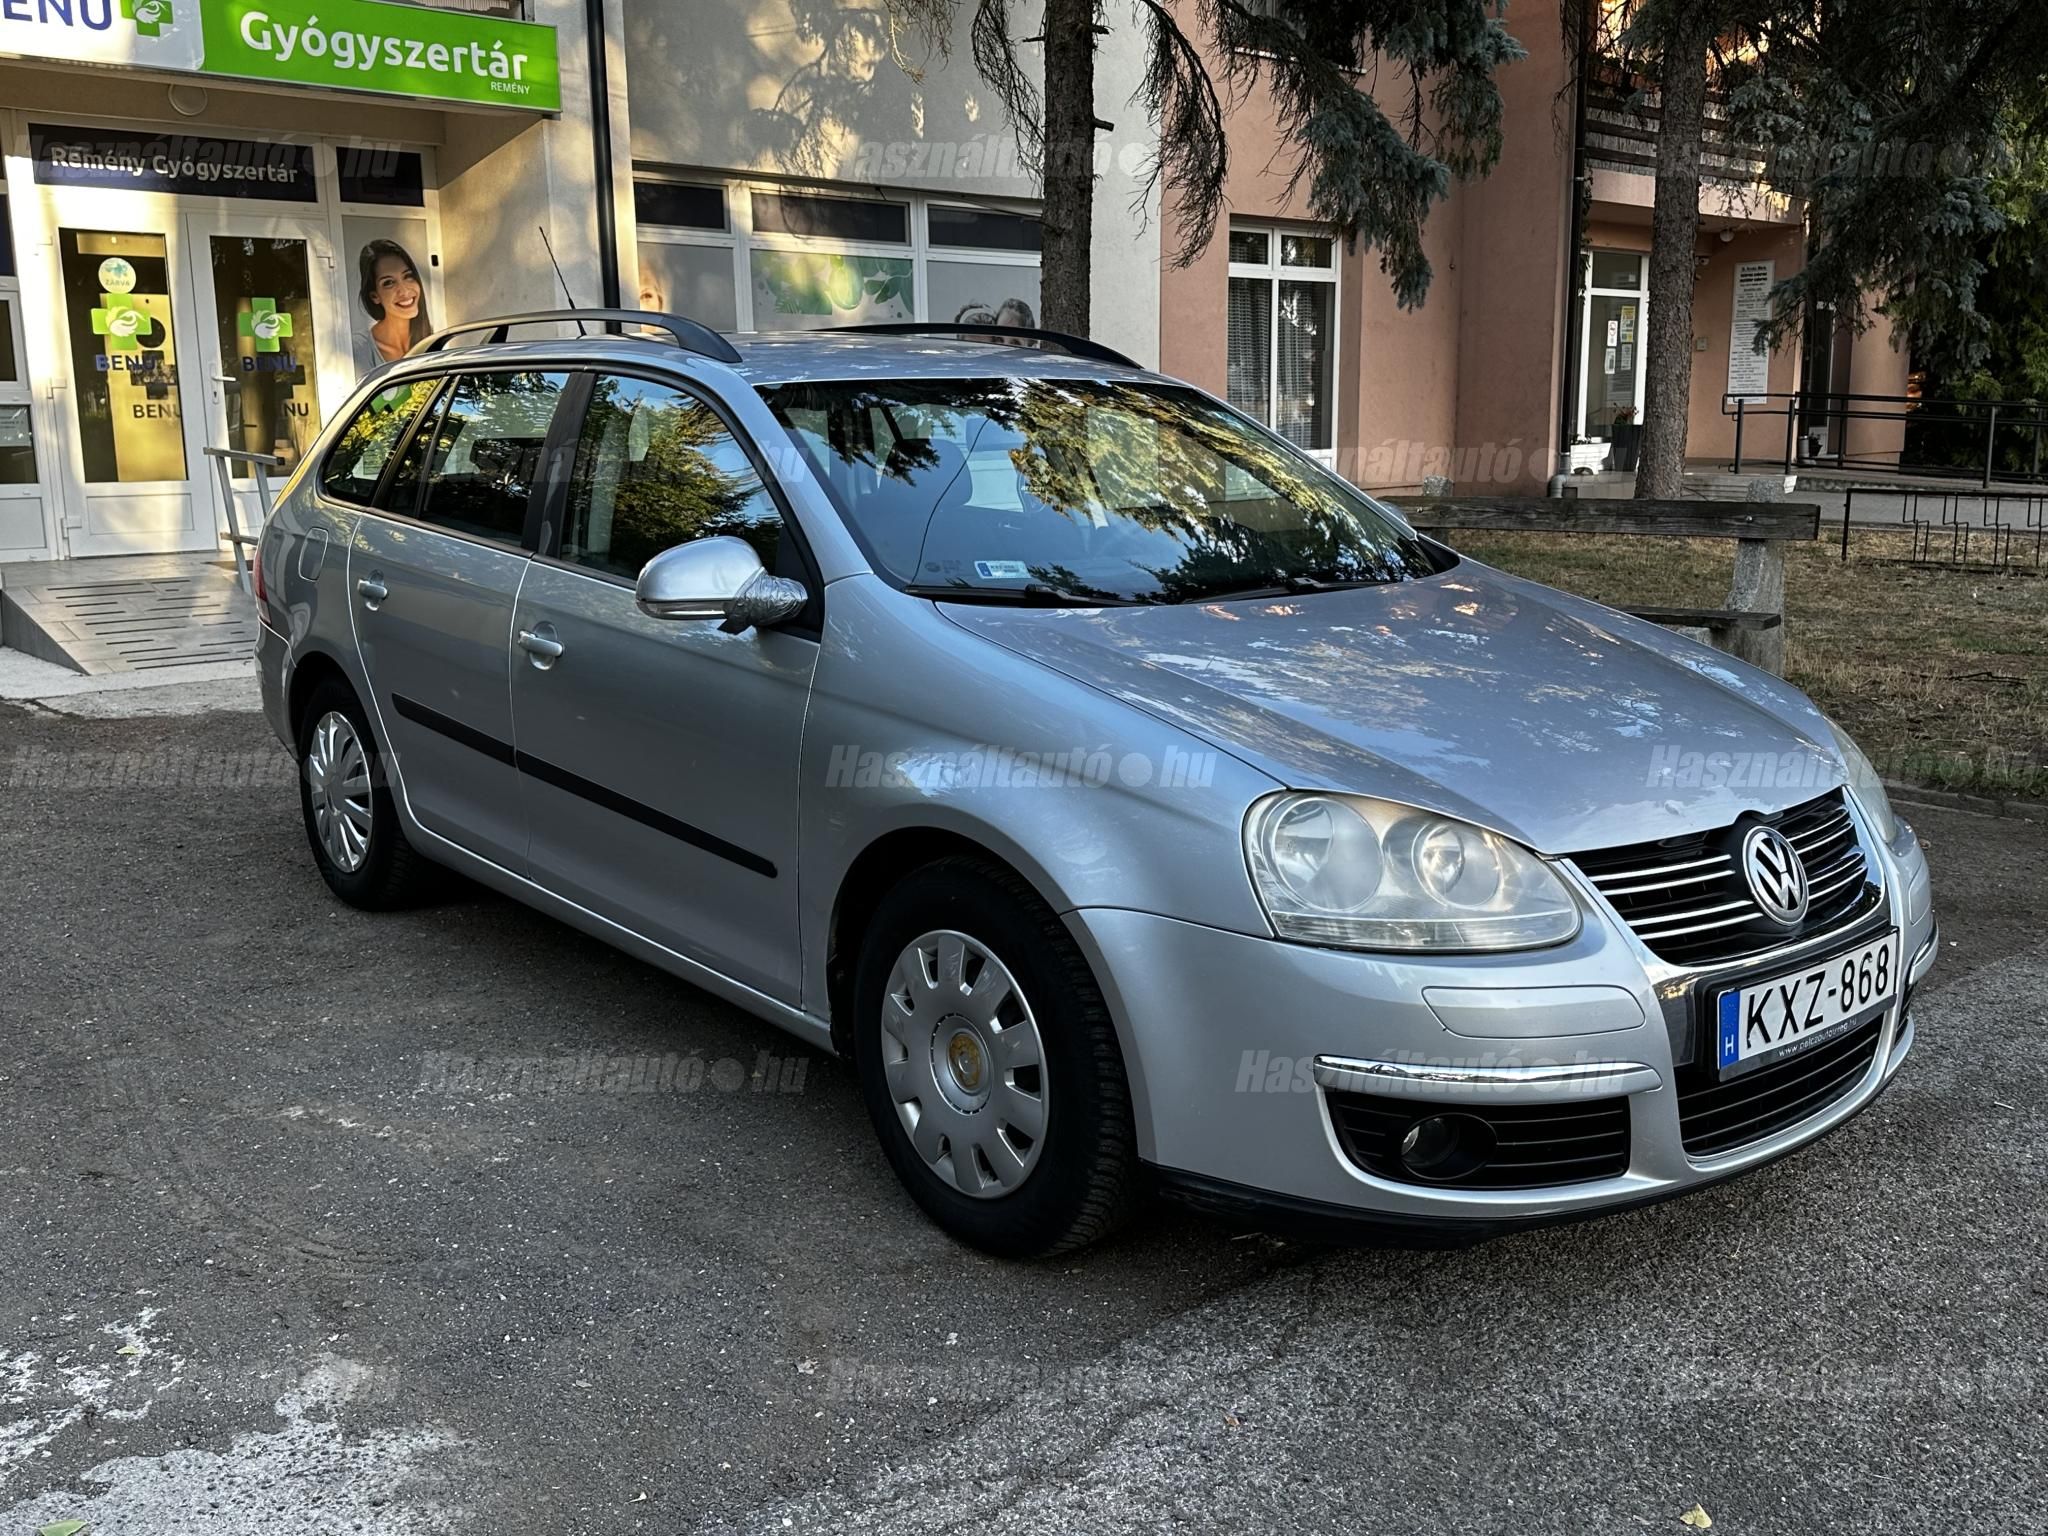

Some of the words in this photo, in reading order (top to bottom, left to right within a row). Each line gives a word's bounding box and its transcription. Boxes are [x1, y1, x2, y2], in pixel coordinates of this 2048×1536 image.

[240, 11, 528, 80] Gyógyszertár
[490, 80, 531, 95] REMÉNY
[51, 145, 146, 176] Remény
[152, 154, 299, 184] Gyógyszertár
[95, 354, 156, 372] BENU
[1746, 943, 1890, 1050] KXZ-868
[1724, 1033, 1735, 1057] H
